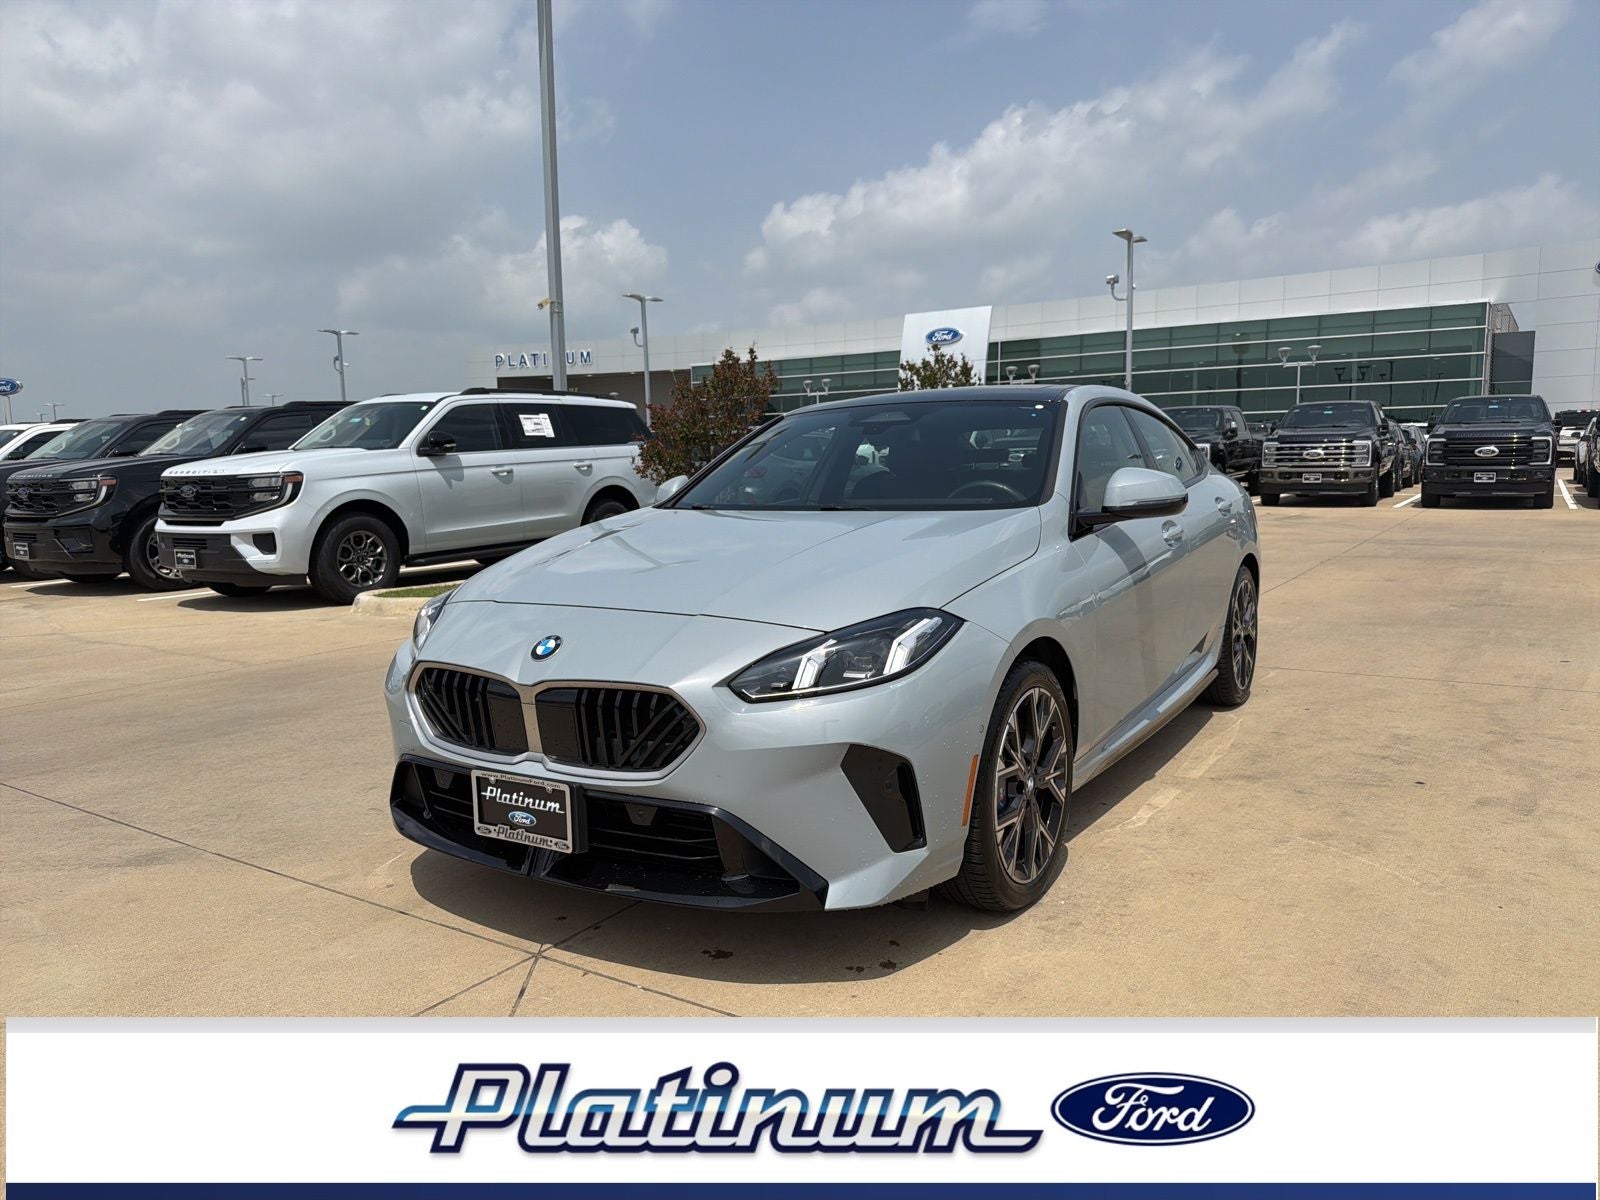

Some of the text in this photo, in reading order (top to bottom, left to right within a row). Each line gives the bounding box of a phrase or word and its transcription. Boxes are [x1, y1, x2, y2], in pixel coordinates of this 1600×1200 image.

[495, 350, 592, 368] PLATIUM
[481, 786, 566, 814] Platinum
[496, 825, 553, 848] Platinum
